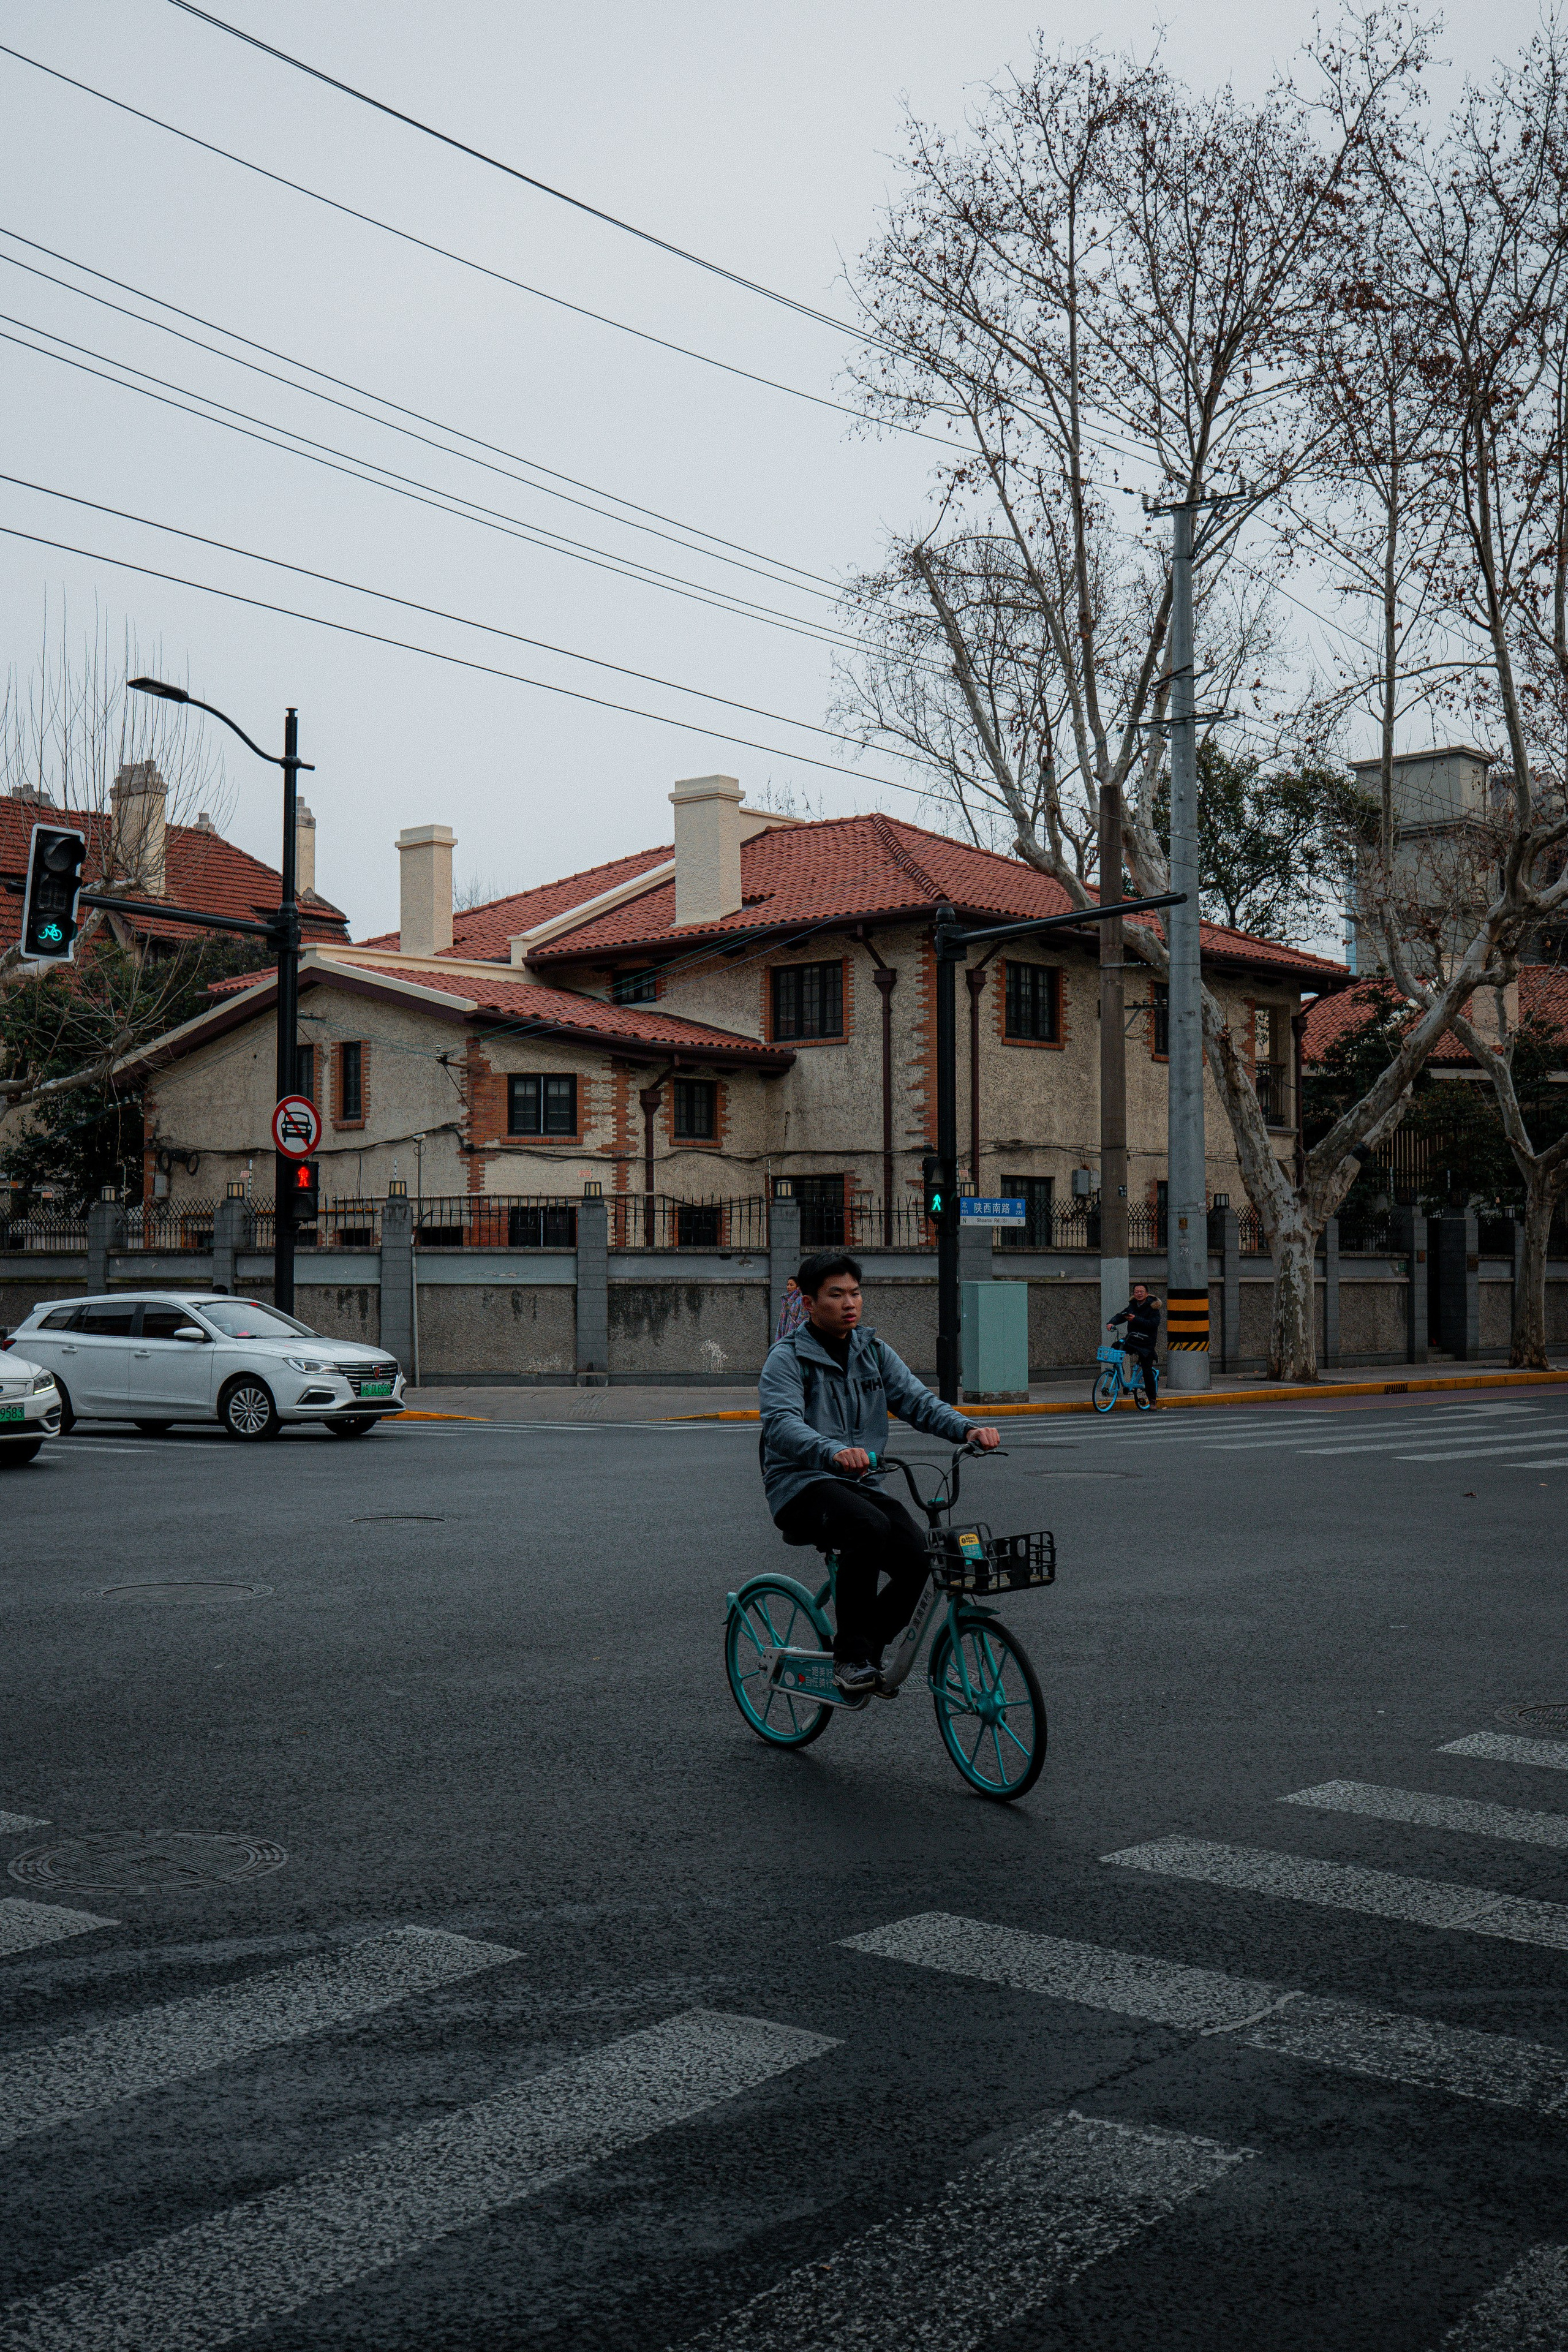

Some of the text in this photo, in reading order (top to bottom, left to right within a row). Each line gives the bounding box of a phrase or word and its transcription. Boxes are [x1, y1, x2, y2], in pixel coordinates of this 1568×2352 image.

[974, 1202, 1010, 1214] 陕西南路
[861, 1377, 883, 1394] HH
[0, 1407, 24, 1419] 9583
[805, 1667, 833, 1678] 一路美好
